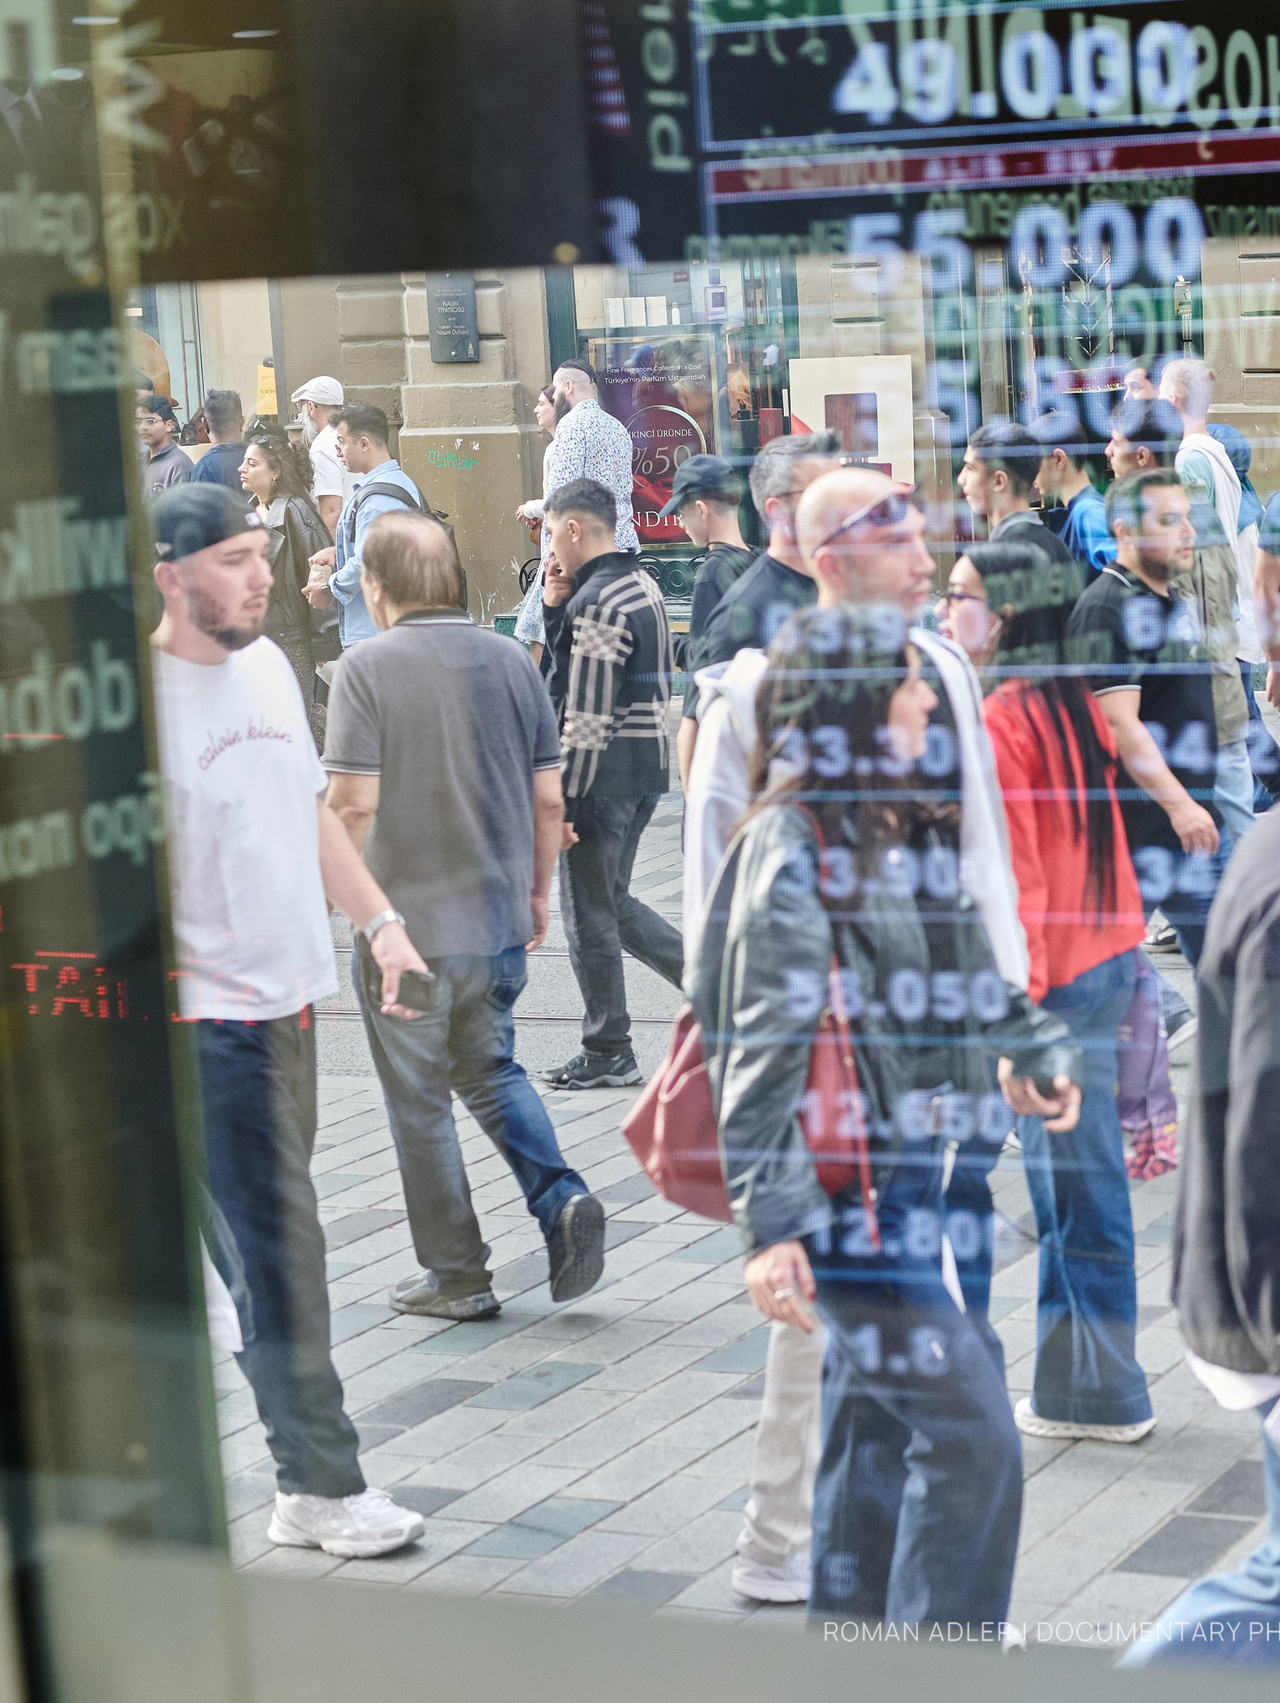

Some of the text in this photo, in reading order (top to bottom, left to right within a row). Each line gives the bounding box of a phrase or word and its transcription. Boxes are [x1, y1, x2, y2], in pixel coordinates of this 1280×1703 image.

[620, 366, 653, 375] Fragrances
[604, 376, 640, 385] Türkiye'nin
[641, 375, 667, 383] Parfüm
[657, 428, 693, 437] ÜRÜNDE
